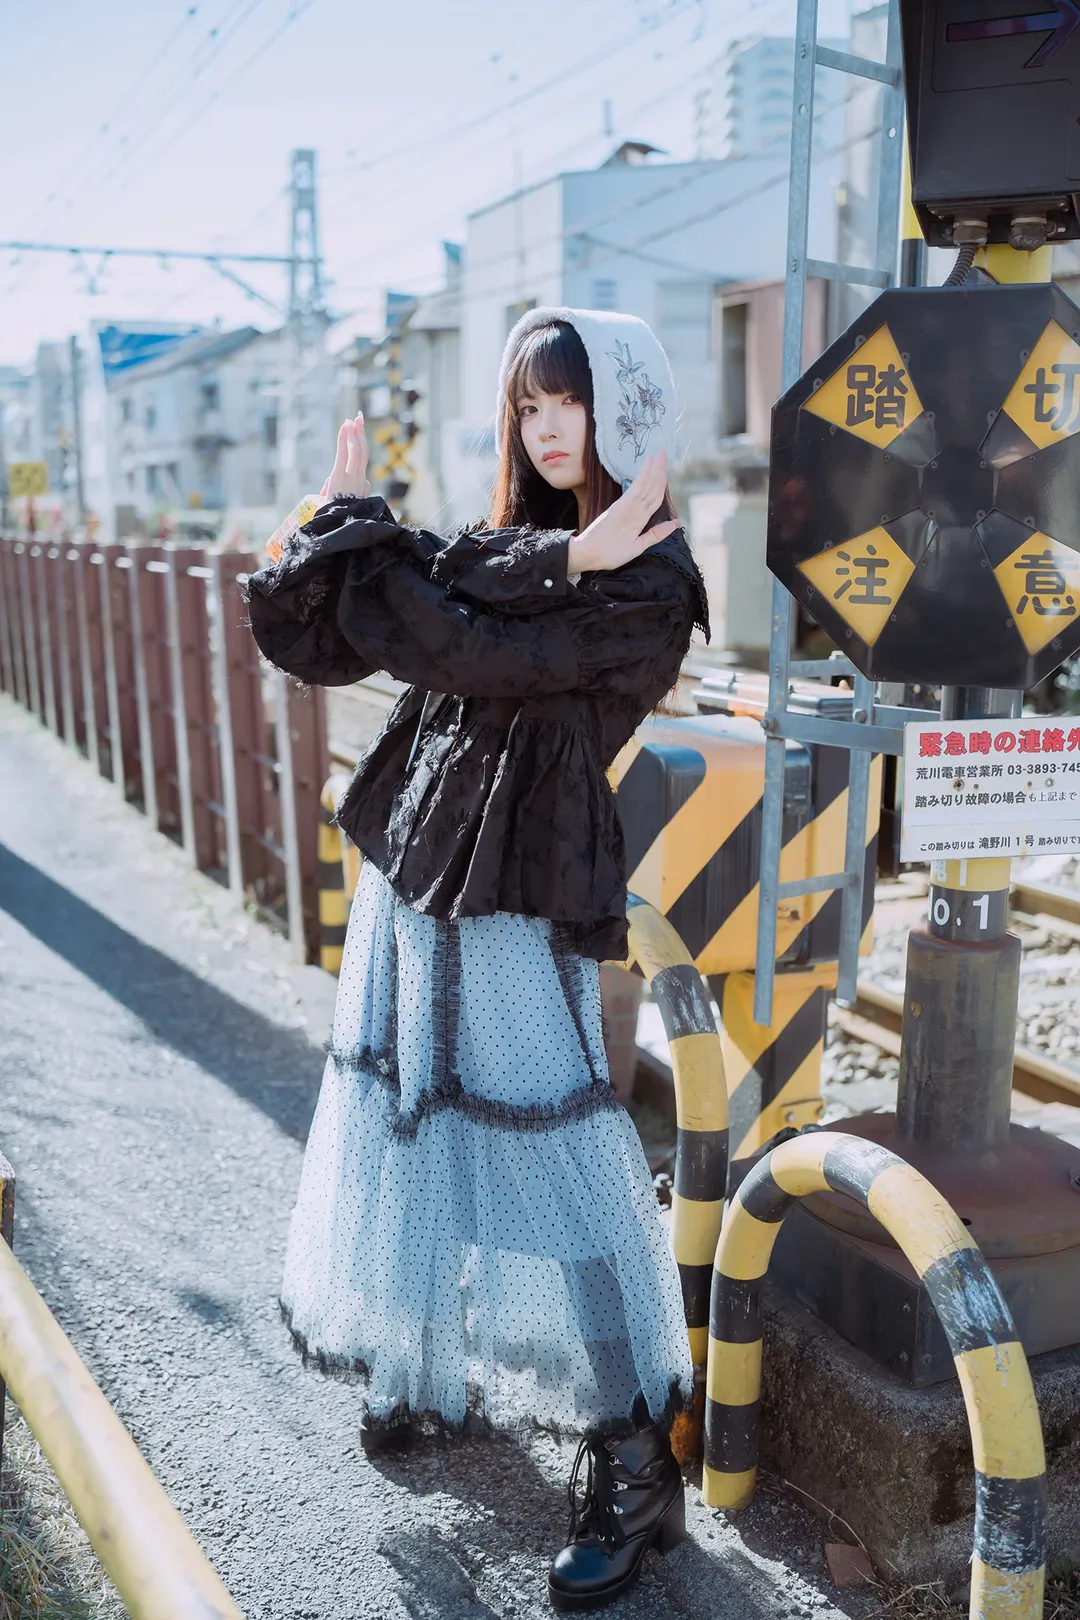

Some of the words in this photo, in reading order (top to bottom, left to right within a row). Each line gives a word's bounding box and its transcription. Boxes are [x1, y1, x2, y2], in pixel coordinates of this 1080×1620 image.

[845, 364, 908, 428] 踏
[1023, 363, 1080, 431] 切
[833, 544, 892, 605] 注
[1013, 549, 1079, 616] 意
[915, 764, 1003, 780] 荒川電車営業所
[920, 841, 975, 851] この踏み切りは
[978, 836, 1011, 849] 滝野川
[1015, 837, 1020, 846] 1
[1024, 835, 1034, 847] 号
[972, 894, 990, 930] 1
